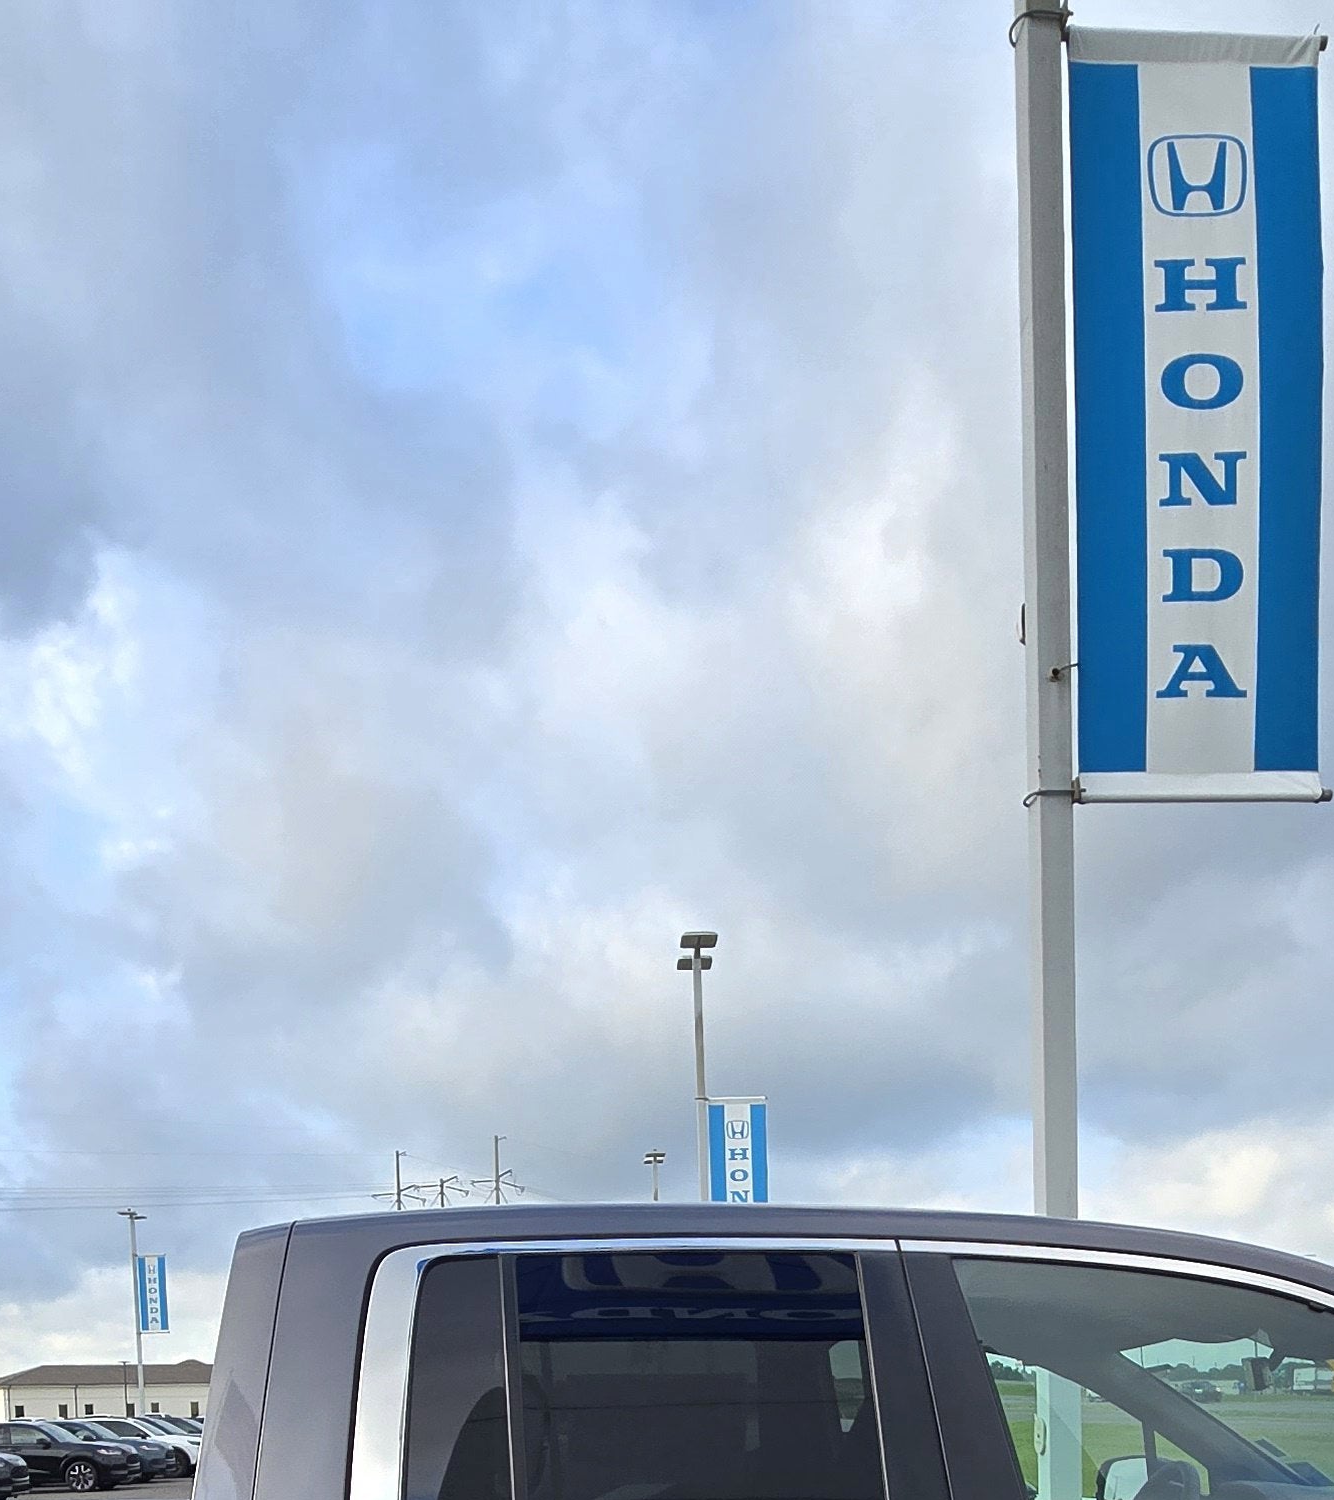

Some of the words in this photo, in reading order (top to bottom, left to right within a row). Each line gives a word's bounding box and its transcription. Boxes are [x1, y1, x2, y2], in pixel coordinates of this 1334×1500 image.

[1153, 257, 1248, 699] HONDA
[728, 1147, 751, 1203] HON
[148, 1278, 159, 1323] HONDA
